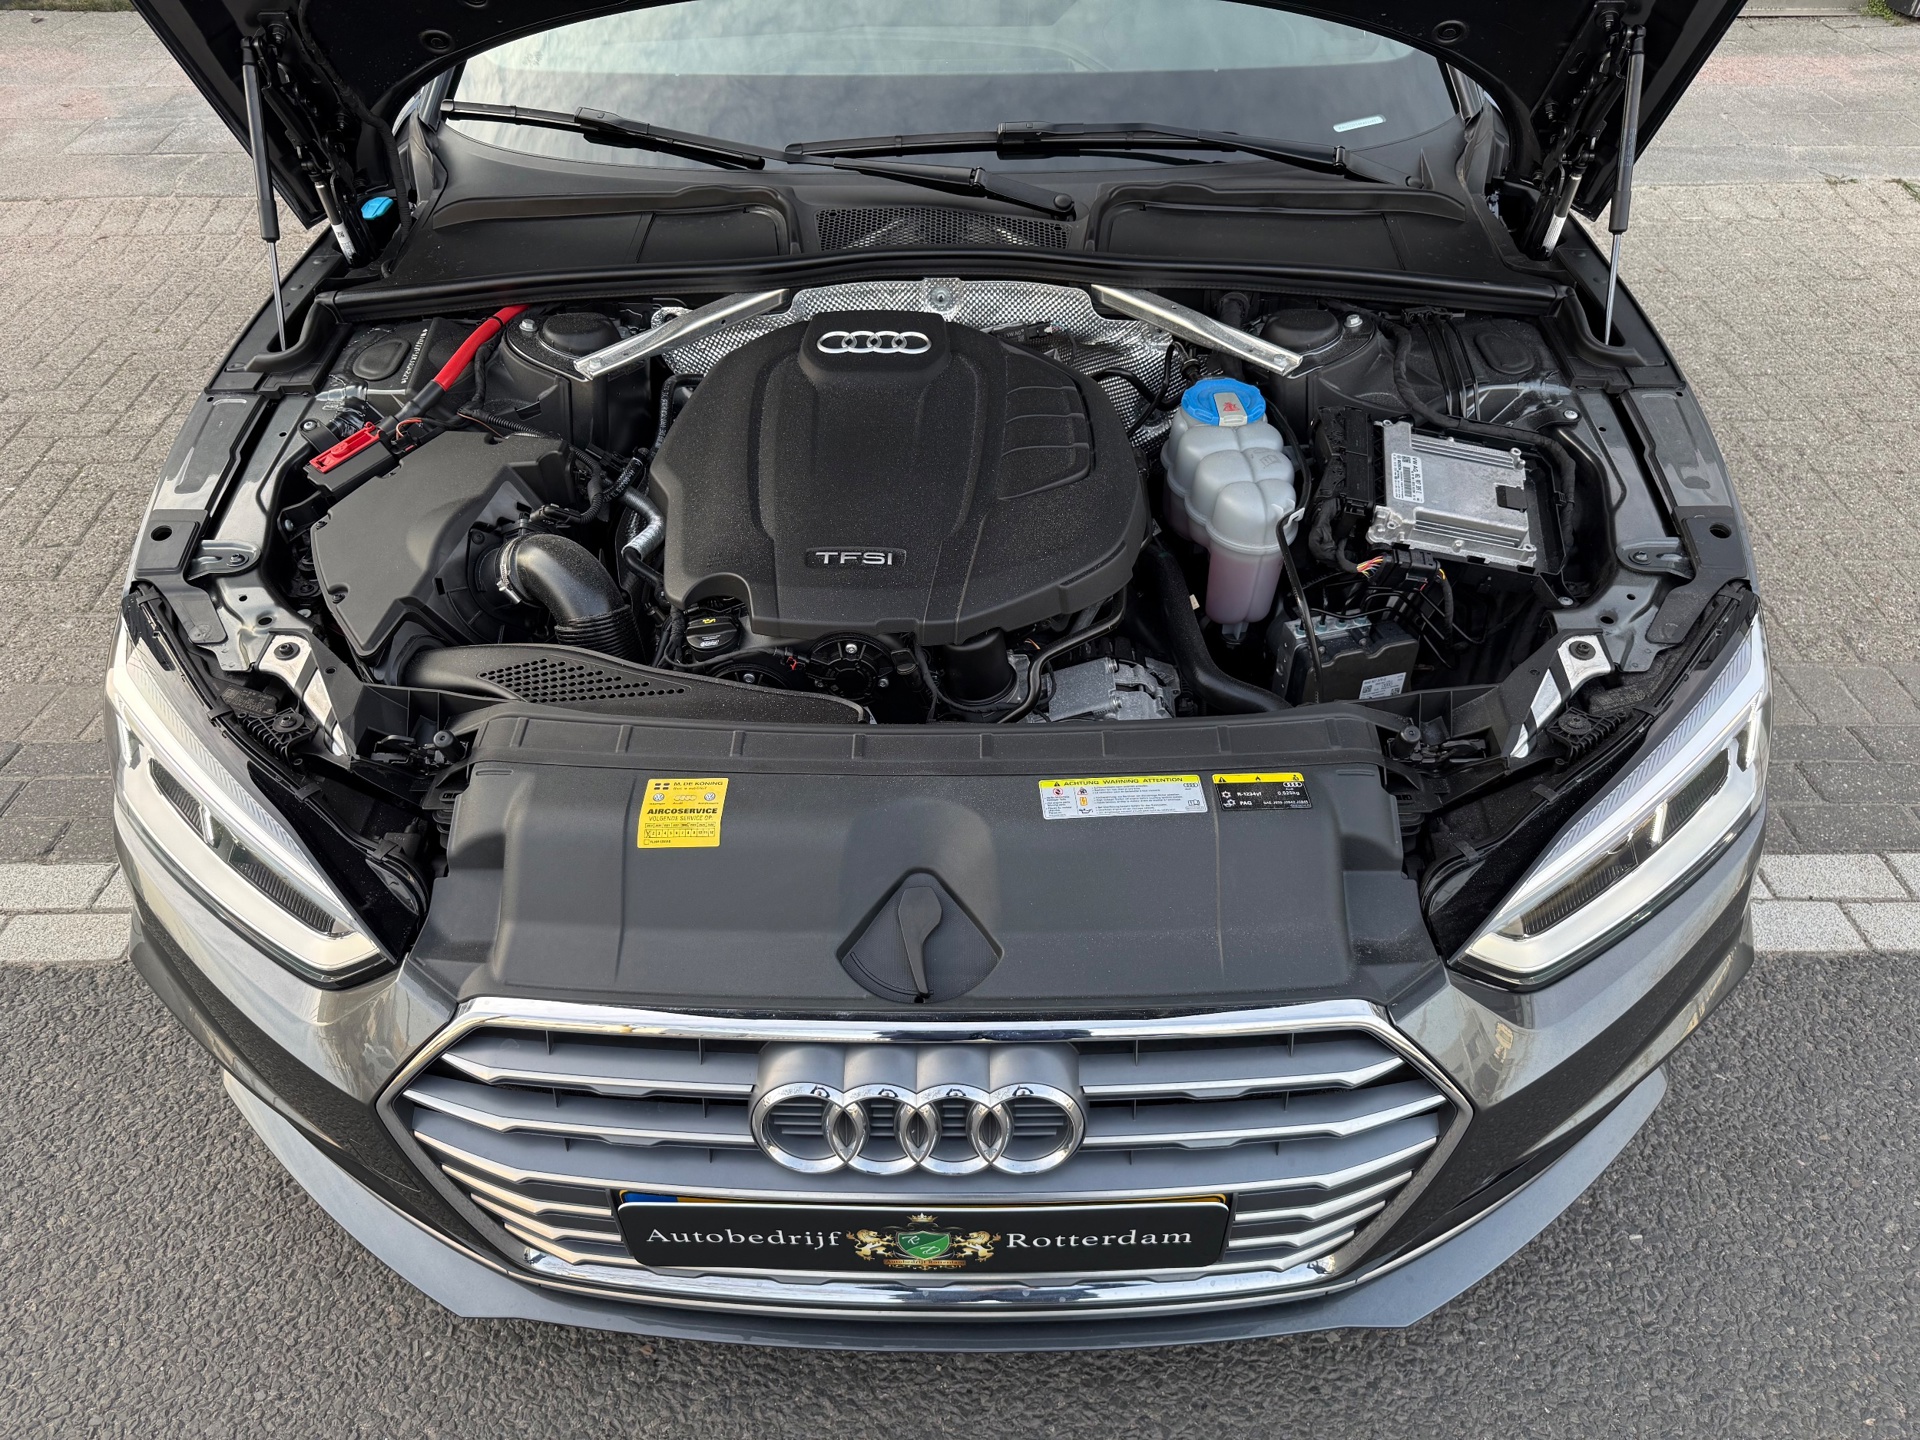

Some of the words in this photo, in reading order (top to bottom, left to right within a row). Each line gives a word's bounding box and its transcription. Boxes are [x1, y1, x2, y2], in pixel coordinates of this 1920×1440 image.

[815, 551, 893, 566] TFSI
[646, 1228, 842, 1250] Autobedrijf
[1006, 1229, 1192, 1248] Rotterdam
